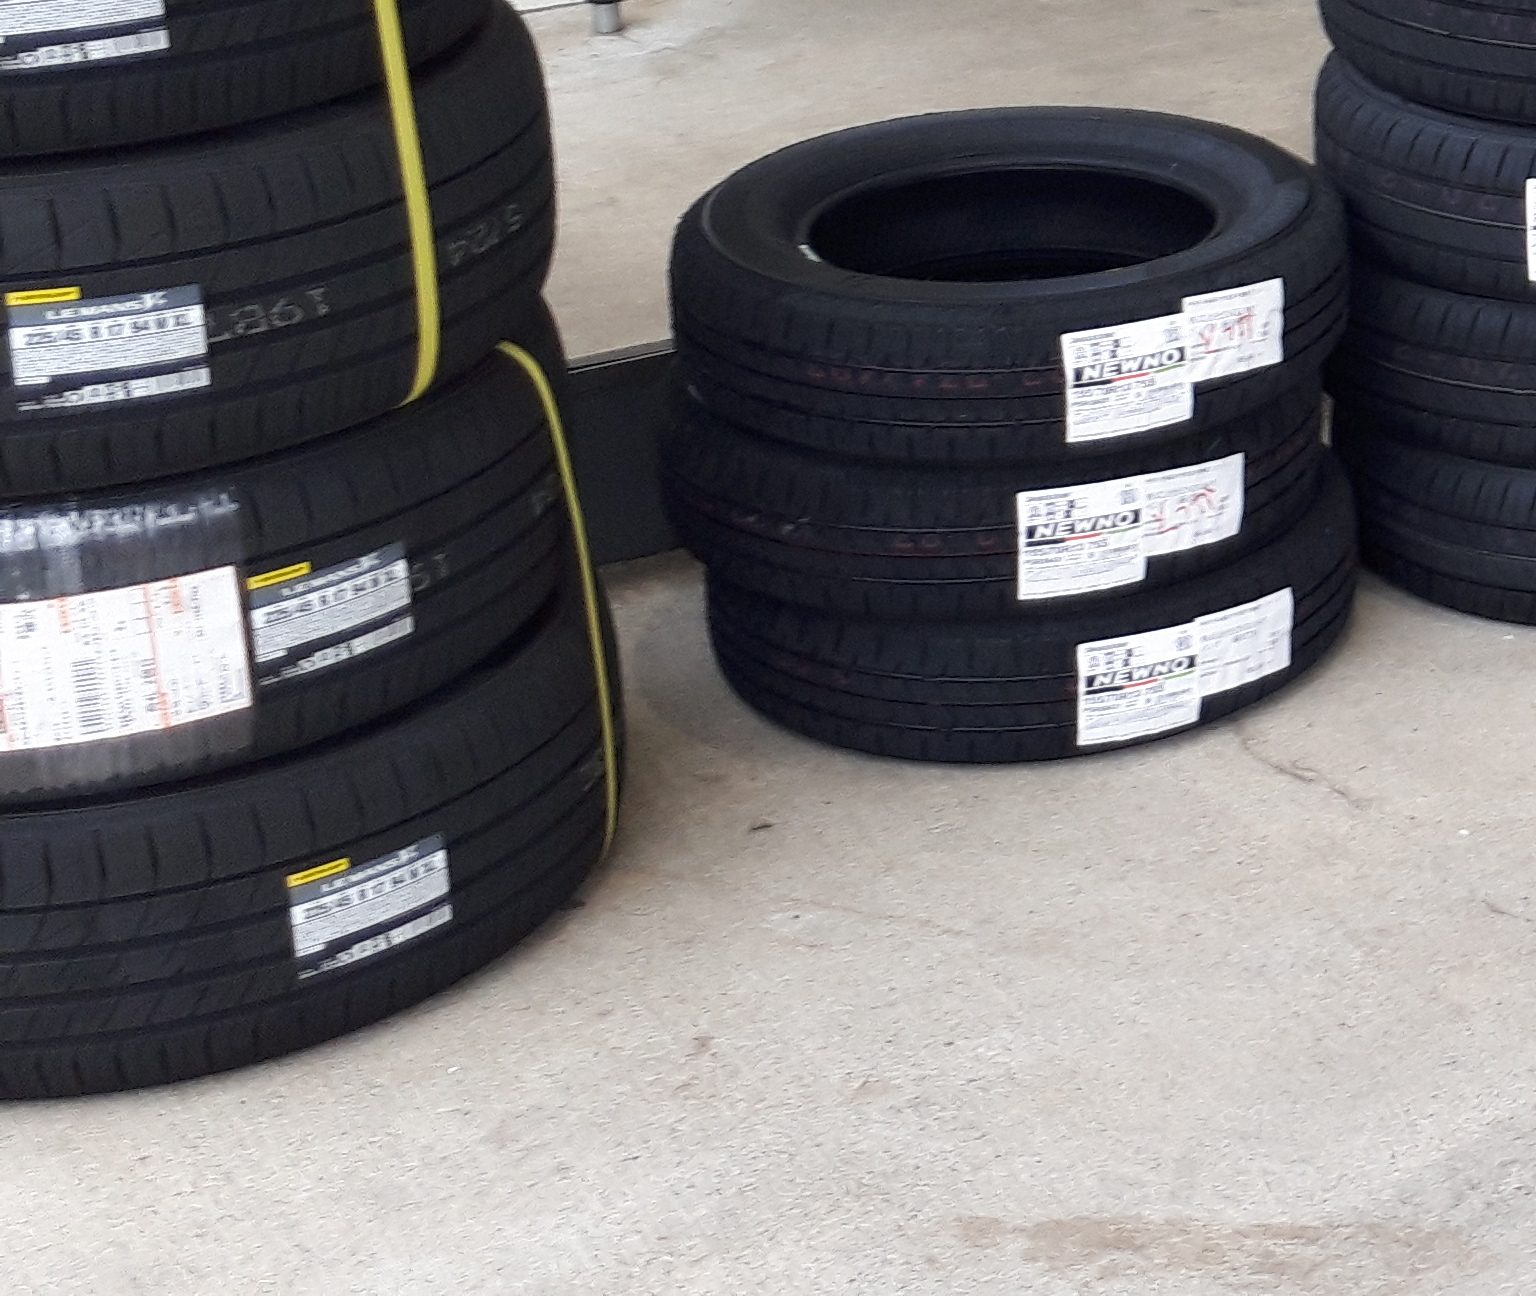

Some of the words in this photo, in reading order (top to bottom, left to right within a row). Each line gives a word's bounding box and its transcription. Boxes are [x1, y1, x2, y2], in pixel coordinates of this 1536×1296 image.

[1079, 347, 1183, 382] NEWNO
[1033, 510, 1137, 540] NEWNO
[1091, 655, 1192, 688] NEWNO
